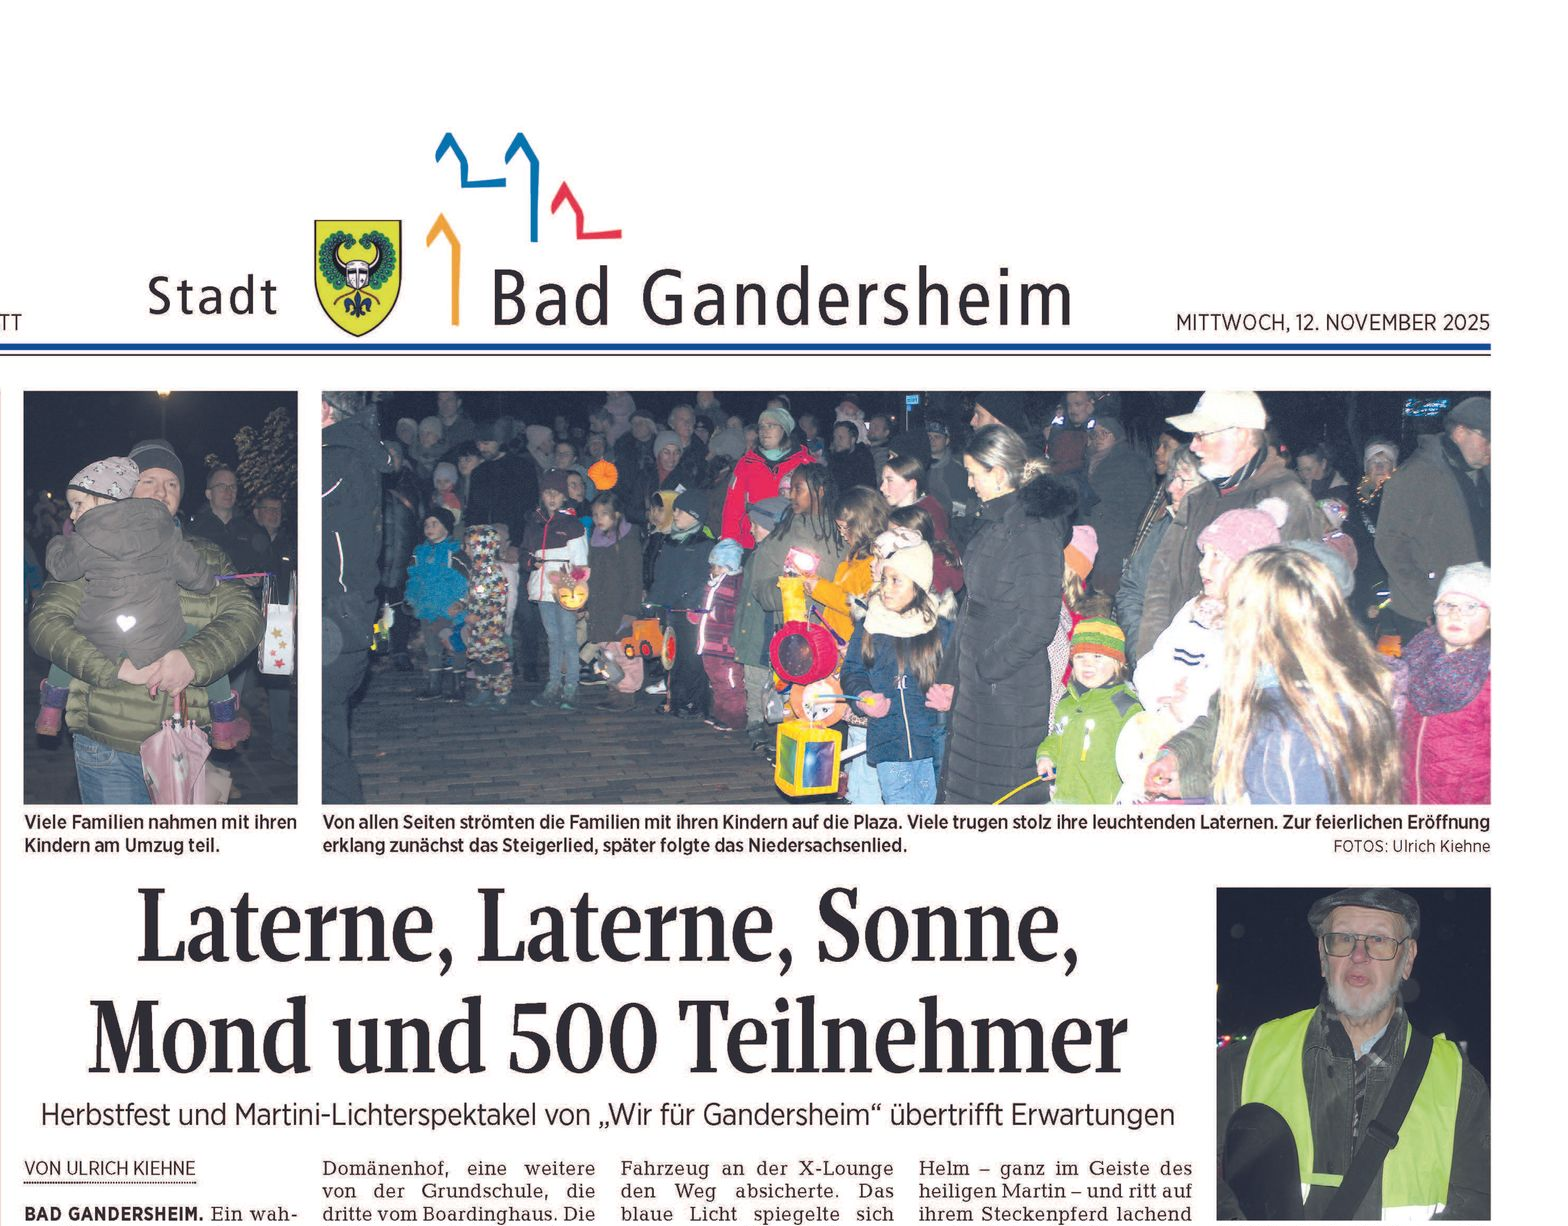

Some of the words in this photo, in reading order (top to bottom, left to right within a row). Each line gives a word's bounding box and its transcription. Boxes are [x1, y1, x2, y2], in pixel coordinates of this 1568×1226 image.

[148, 273, 277, 316] Stadt
[494, 264, 608, 327] Bad
[642, 264, 1071, 326] Gandersheim
[1176, 313, 1290, 334] MITTWOCH,
[1295, 313, 1319, 331] 12.
[1326, 313, 1437, 331] NOVEMBER
[1443, 313, 1490, 331] 2025
[24, 813, 67, 830] Viele
[72, 813, 144, 830] Familien
[148, 813, 217, 830] nahmen
[221, 814, 250, 830] mit
[254, 813, 297, 830] ihren
[322, 814, 355, 830] Von
[358, 813, 399, 830] allen
[402, 814, 456, 830] Seiten
[459, 814, 535, 830] strömten
[539, 813, 565, 830] die
[569, 813, 640, 830] Familien
[644, 814, 672, 830] mit
[676, 813, 719, 830] ihren
[722, 813, 788, 830] Kindern
[791, 813, 820, 830] auf
[822, 813, 850, 830] die
[853, 813, 903, 830] Plaza.
[906, 813, 949, 830] Viele
[952, 814, 1008, 833] trugen
[1012, 813, 1052, 830] stolz
[1057, 813, 1088, 830] ihre
[1092, 813, 1196, 830] leuchtenden
[1200, 814, 1278, 830] Laternen.
[1282, 814, 1312, 830] Zur
[1315, 813, 1403, 830] feierlichen
[1407, 813, 1490, 833] Eröffnung
[24, 836, 91, 853] Kindern
[94, 840, 120, 853] am
[125, 837, 184, 856] Umzug
[188, 836, 220, 853] teil.
[322, 836, 386, 856] erklang
[389, 836, 465, 853] zunächst
[468, 836, 499, 853] das
[502, 836, 599, 856] Steigerlied,
[602, 837, 657, 856] später
[659, 836, 711, 856] folgte
[714, 836, 744, 853] das
[748, 836, 907, 853] Niedersachsenlied.
[1334, 839, 1388, 853] FOTOS:
[1393, 839, 1436, 853] Ulrich
[1440, 839, 1491, 853] Kiehne
[137, 887, 453, 977] Laterne,
[477, 887, 793, 977] Laterne,
[818, 886, 1078, 977] Sonne,
[88, 994, 312, 1074] Mond
[332, 994, 487, 1074] und
[509, 1002, 658, 1074] 500
[678, 994, 1128, 1074] Teilnehmer
[42, 1102, 171, 1127] Herbstfest
[179, 1102, 226, 1126] und
[235, 1101, 536, 1131] Martini-Lichterspektakel
[544, 1107, 590, 1127] von
[659, 1102, 696, 1126] für
[890, 1101, 1004, 1127] übertrifft
[1012, 1102, 1175, 1131] Erwartungen
[24, 1160, 61, 1176] VON
[67, 1160, 128, 1176] ULRICH
[133, 1160, 196, 1176] KIEHNE
[322, 1160, 449, 1179] Domänenhof,
[467, 1160, 507, 1176] eine
[523, 1160, 596, 1176] weitere
[620, 1160, 710, 1180] Fahrzeug
[721, 1163, 745, 1176] an
[756, 1160, 788, 1176] der
[798, 1160, 894, 1180] X-Lounge
[24, 1206, 62, 1222] BAD
[68, 1206, 204, 1222] GANDERSHEIM.
[210, 1206, 243, 1222] Ein
[249, 1206, 298, 1222] wah-
